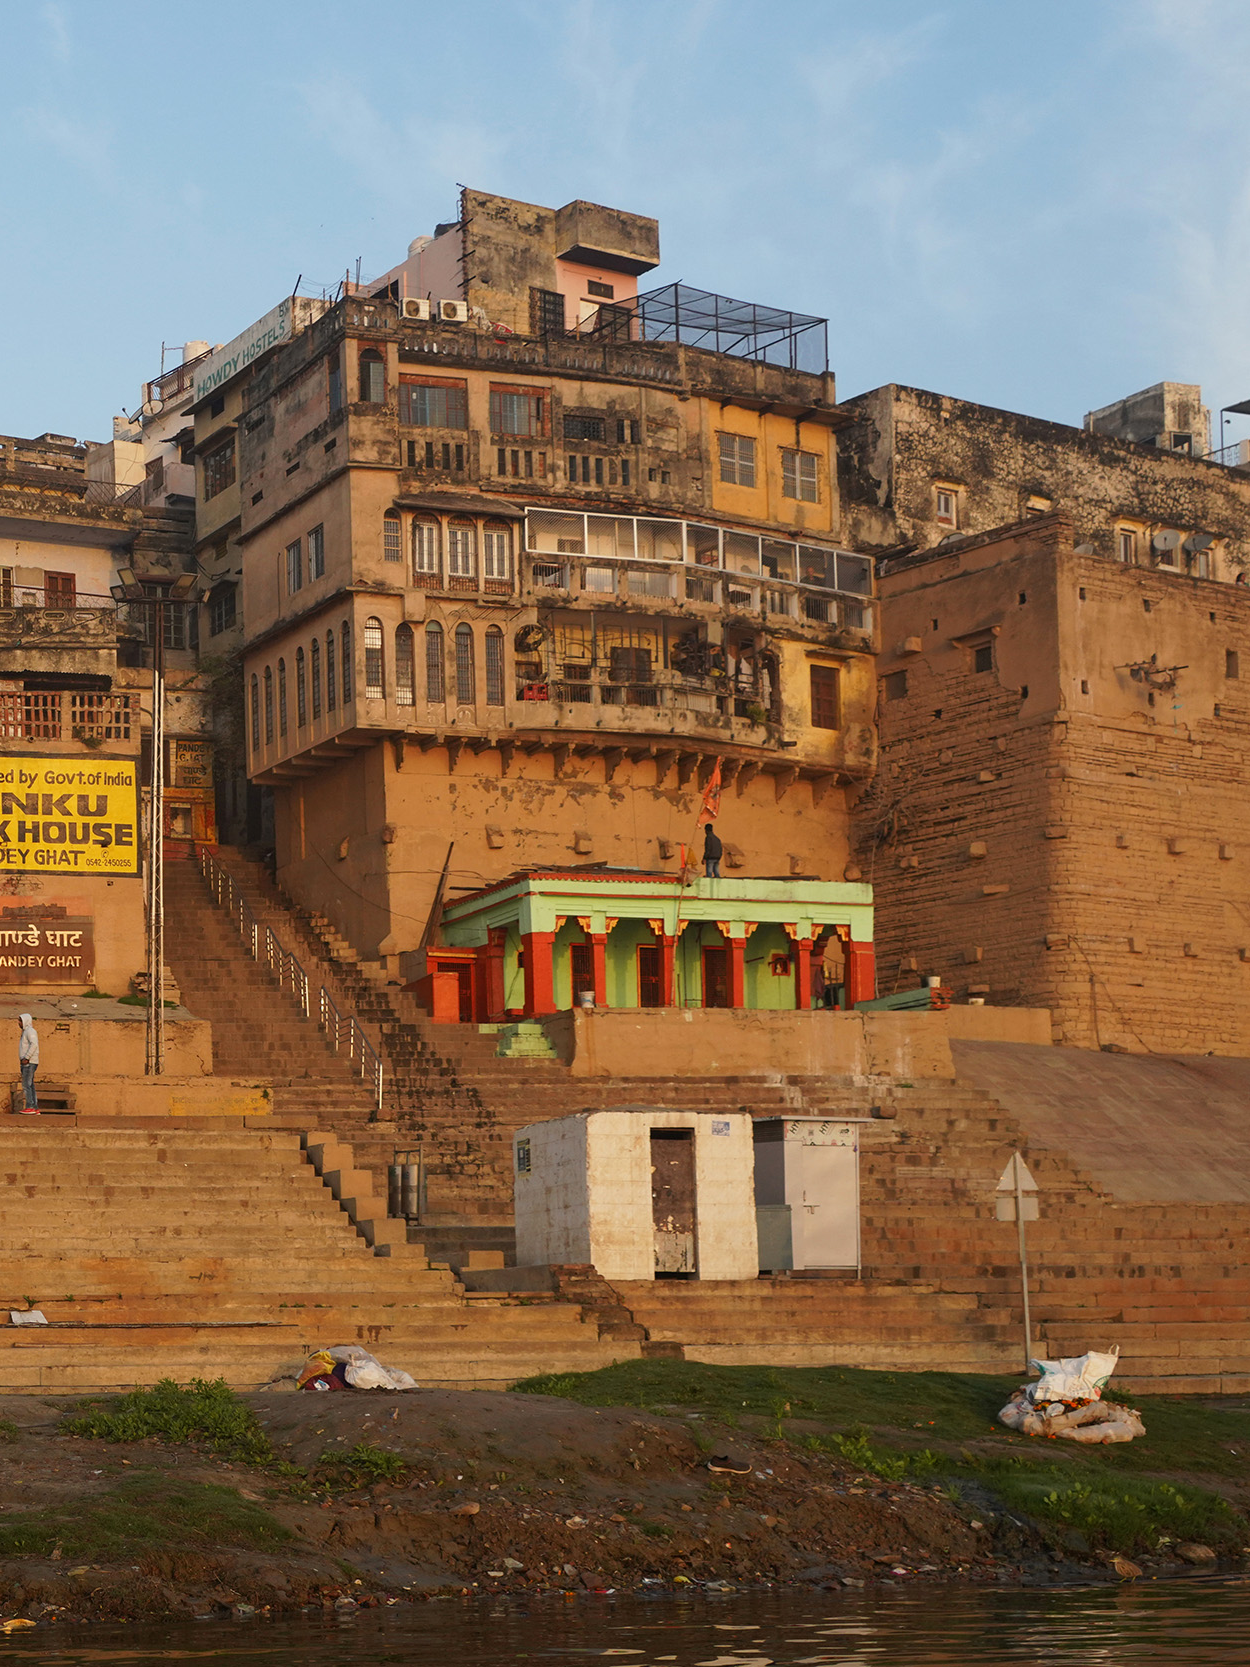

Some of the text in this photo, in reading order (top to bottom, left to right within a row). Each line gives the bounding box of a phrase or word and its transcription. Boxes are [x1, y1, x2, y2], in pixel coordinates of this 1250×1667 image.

[197, 320, 285, 401] HOWDY HOSTELS
[18, 769, 39, 788] by
[104, 771, 133, 787] India
[17, 820, 134, 847] HOUSE
[34, 849, 86, 866] GHAT
[85, 858, 132, 868] 0542-2450255
[45, 930, 83, 947] घाट
[47, 955, 82, 968] GHAT
